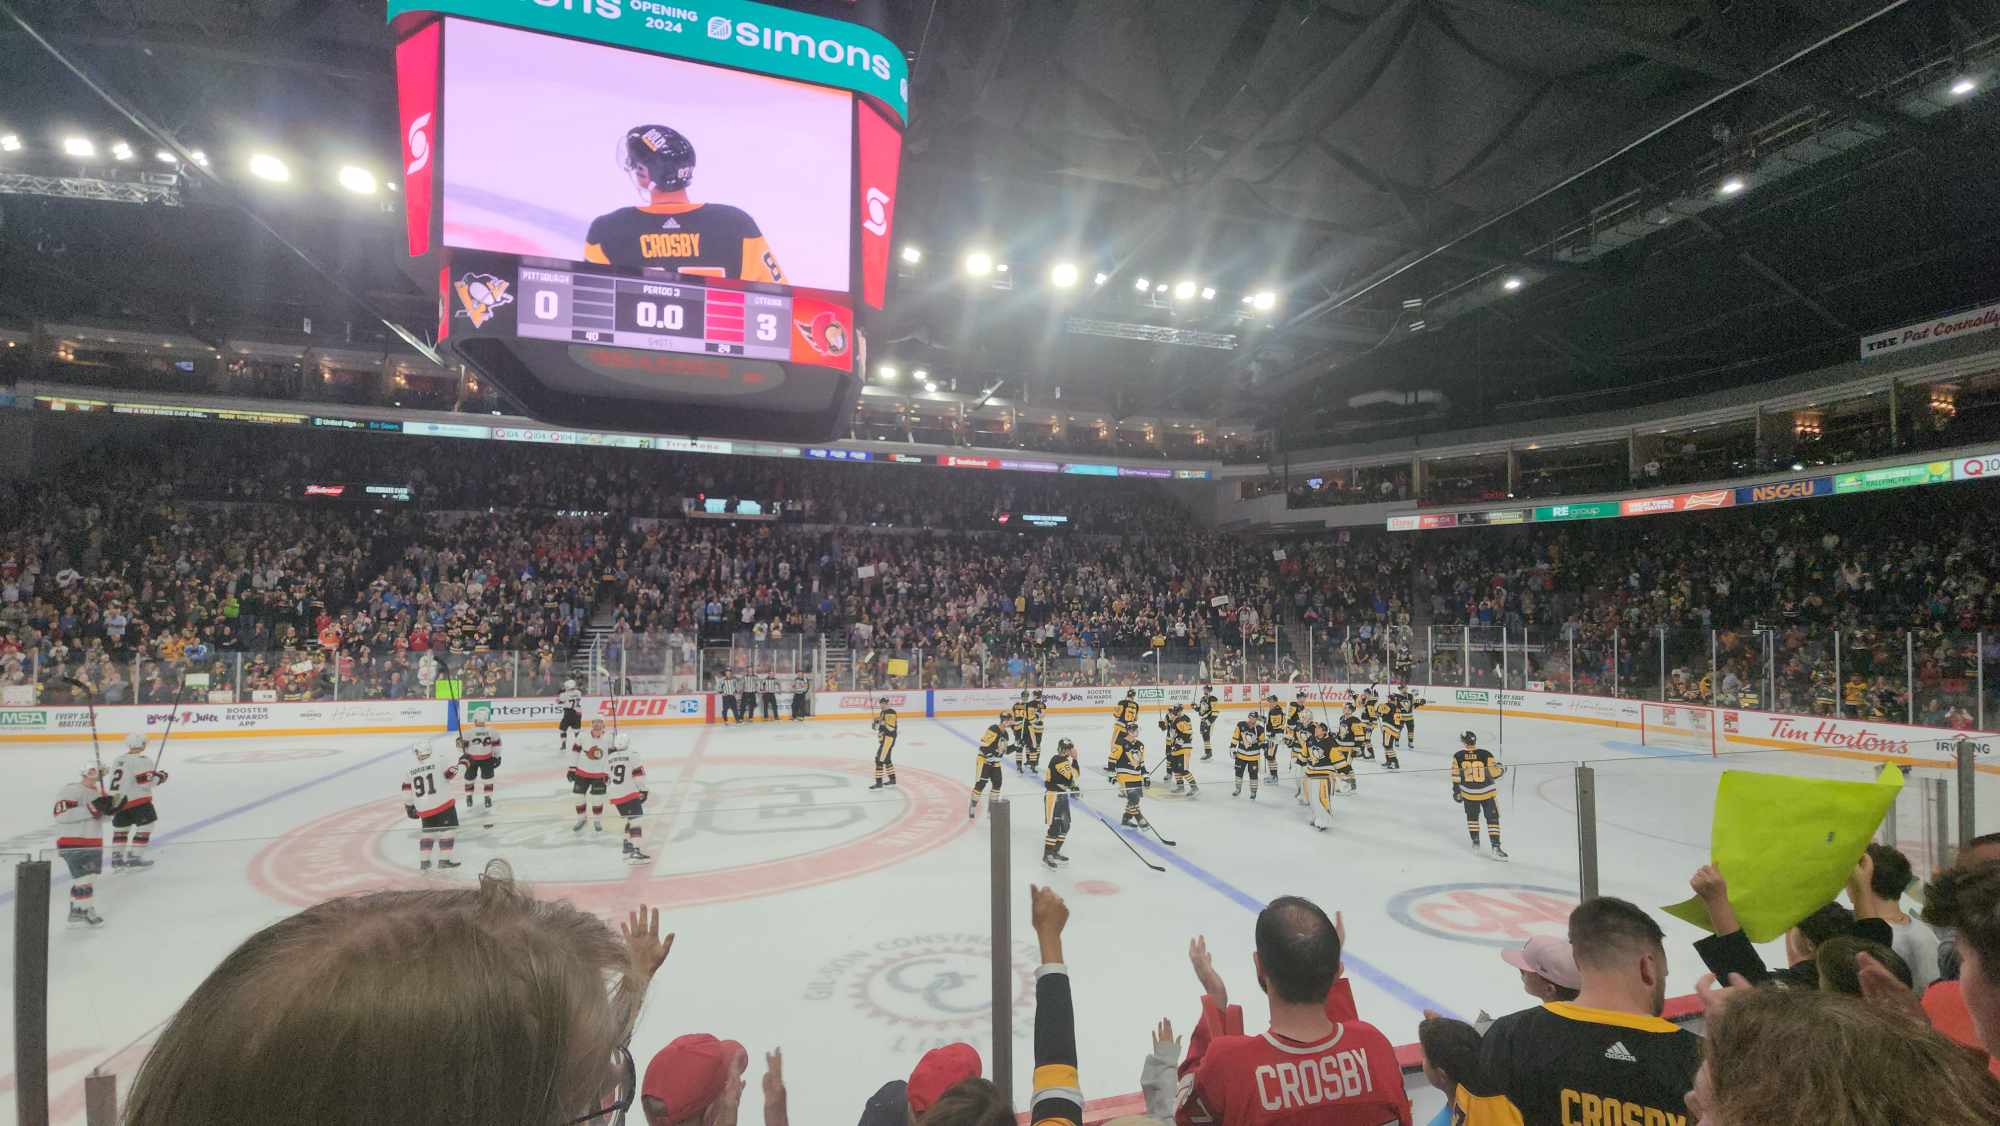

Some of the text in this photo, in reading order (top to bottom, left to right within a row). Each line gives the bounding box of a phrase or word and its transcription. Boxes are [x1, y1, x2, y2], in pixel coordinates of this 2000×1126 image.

[630, 0, 698, 22] OPENING
[645, 17, 683, 33] 2024
[735, 22, 891, 81] simons
[640, 233, 700, 258] CROSBY
[643, 285, 673, 297] PERIOD
[535, 290, 558, 320] 0
[636, 301, 684, 330] 0.0
[756, 313, 777, 341] 3
[1867, 336, 1897, 351] THE
[1902, 327, 1930, 344] Pat
[1752, 481, 1814, 501] NSGEU
[1553, 506, 1600, 519] RE group
[1456, 690, 1488, 701] MSA
[1, 711, 45, 724] MSA
[596, 699, 668, 716] SICO
[1769, 717, 1808, 741] Tim
[1813, 720, 1910, 754] Hortons
[1461, 760, 1486, 783] 20
[413, 772, 437, 798] 91
[1604, 1051, 1637, 1062] adidas
[1254, 1047, 1373, 1111] CROSBY
